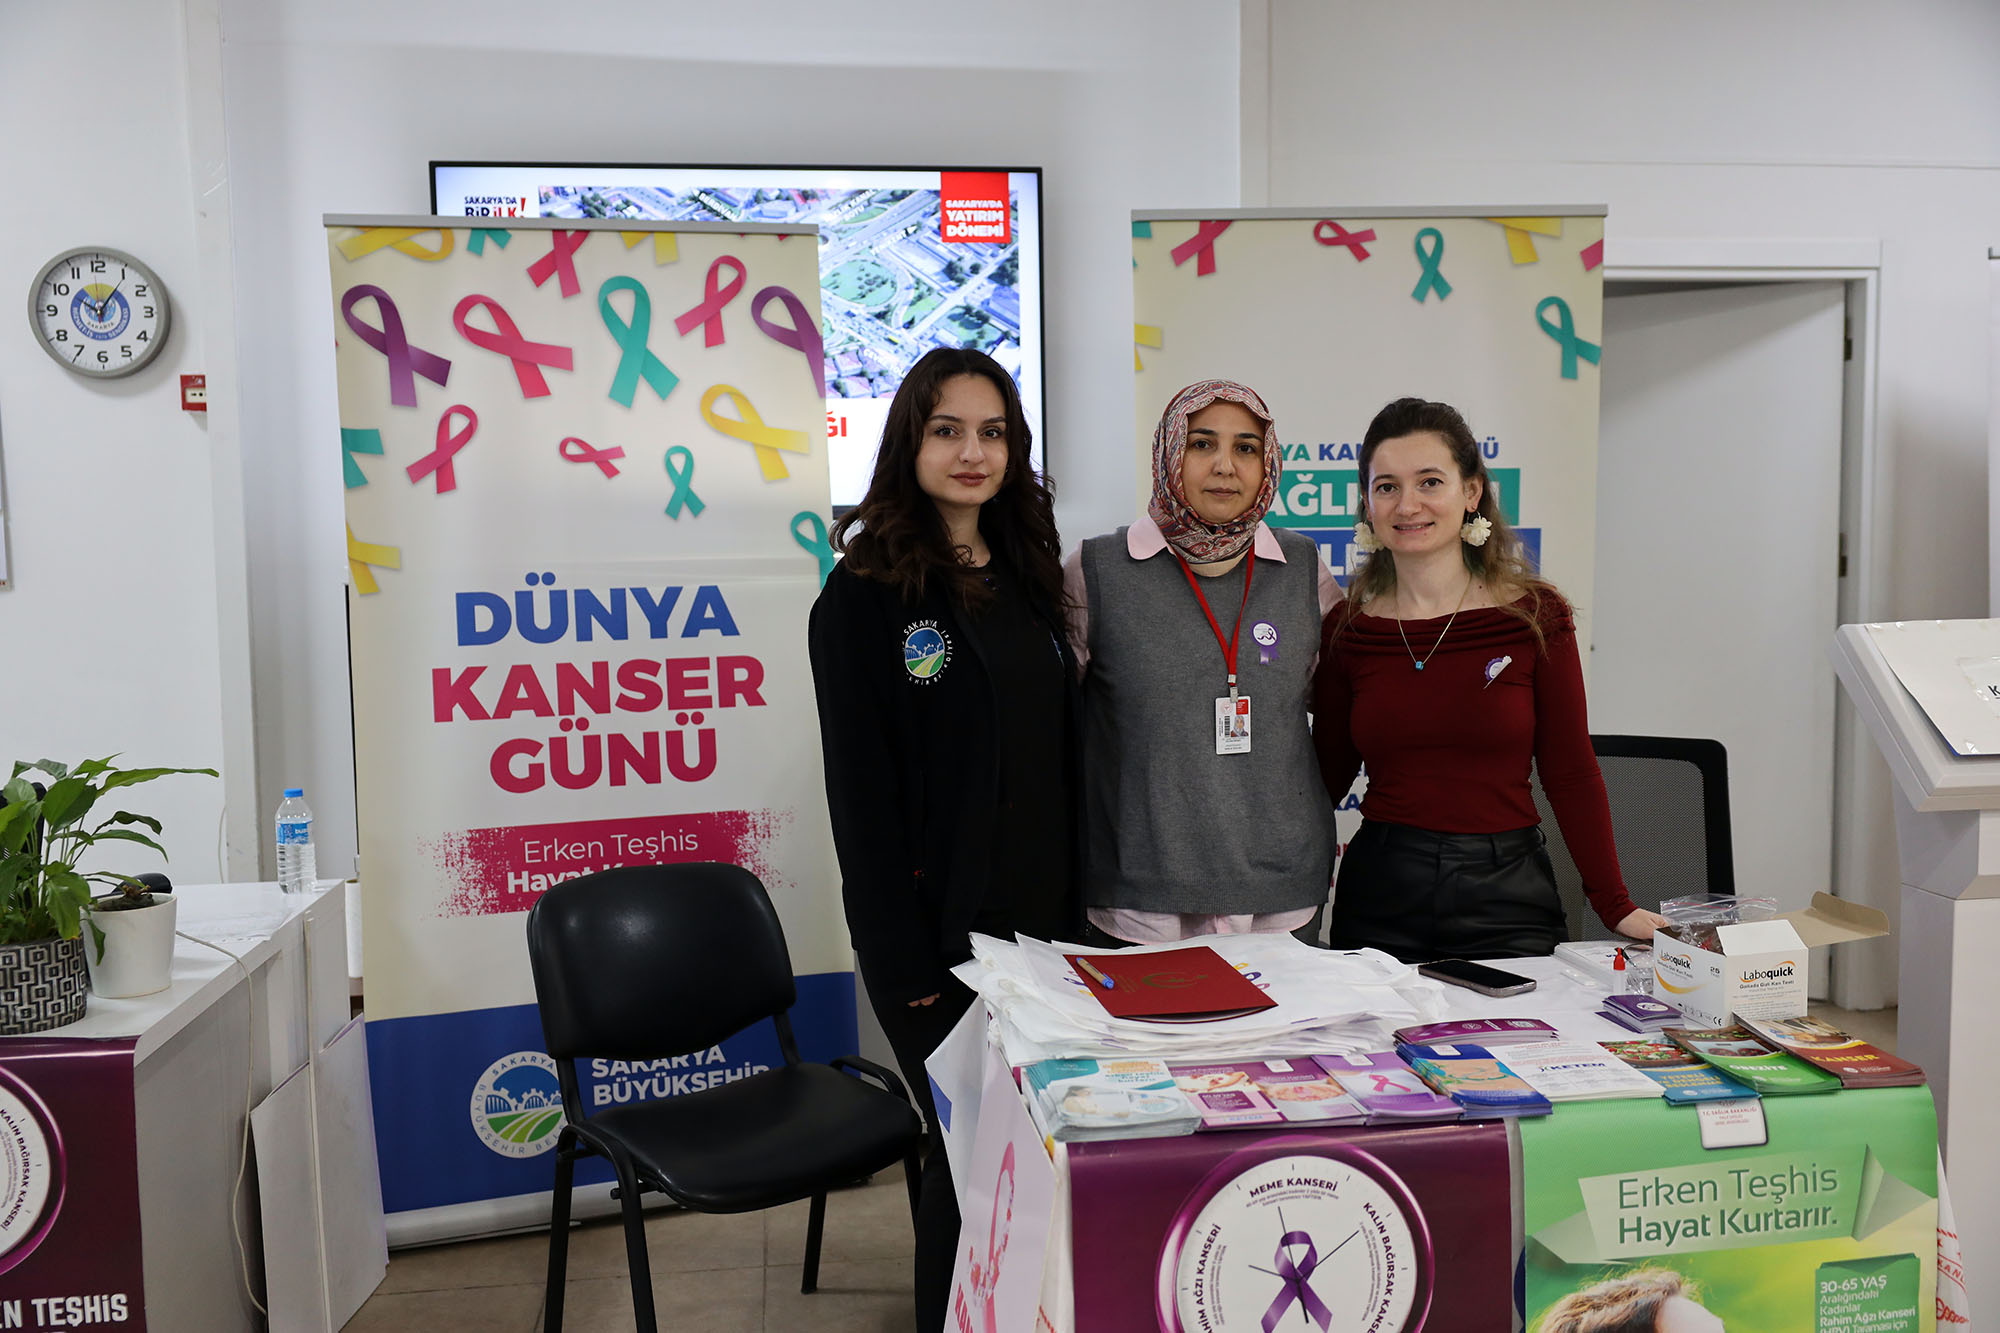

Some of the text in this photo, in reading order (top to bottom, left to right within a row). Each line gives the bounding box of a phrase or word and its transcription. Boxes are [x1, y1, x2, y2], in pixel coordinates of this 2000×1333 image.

[464, 196, 517, 204] SAKARYA'DA
[946, 210, 1004, 222] YATIRIM
[946, 222, 1004, 237] DÖNEMİ
[71, 267, 80, 279] 11
[90, 260, 106, 273] 12
[121, 268, 125, 280] 1
[53, 283, 70, 296] 10
[135, 285, 147, 297] 2
[46, 305, 58, 317] 9
[144, 306, 154, 318] 3
[56, 330, 68, 342] 8
[136, 330, 148, 342] 4
[74, 345, 85, 357] 7
[97, 351, 108, 363] 6
[121, 346, 132, 357] 5
[826, 411, 847, 437] ĞI
[455, 571, 740, 646] DÜNYA
[903, 620, 938, 636] SAKARYA
[432, 655, 767, 722] KANSER
[490, 711, 718, 794] GÜNÜ
[524, 828, 698, 863] Erken Teşhis
[1660, 949, 1691, 970] Laboquick
[1743, 966, 1794, 980] Laboquick
[492, 1055, 554, 1076] SAKARYA
[1810, 1054, 1881, 1062] KANSER
[0, 1109, 21, 1136] KALIN
[16, 1137, 30, 1188] BAĞIRSAK
[1249, 1179, 1284, 1198] MEME
[1287, 1178, 1338, 1191] KANSERİ
[1619, 1163, 1838, 1210] Erken Teşhis
[0, 1190, 27, 1231] KANSERİ
[1363, 1202, 1387, 1234] KALIN
[1619, 1206, 1838, 1247] Hayat Kurtarır.
[1196, 1223, 1222, 1275] KANSERİ
[1381, 1235, 1396, 1296] BAĞIRSAK
[1193, 1278, 1204, 1306] AĞZI
[1820, 1275, 1887, 1294] 30-65 YAŞ
[1820, 1289, 1879, 1305] Aralığındaki
[31, 1293, 128, 1327] TEŞHİS
[1367, 1298, 1391, 1333] KANSE
[1820, 1303, 1861, 1316] Kadınlar
[1820, 1306, 1916, 1327] Rahim Ağzı Kanseri
[1198, 1308, 1213, 1333] AHİM
[1891, 1320, 1908, 1333] için
